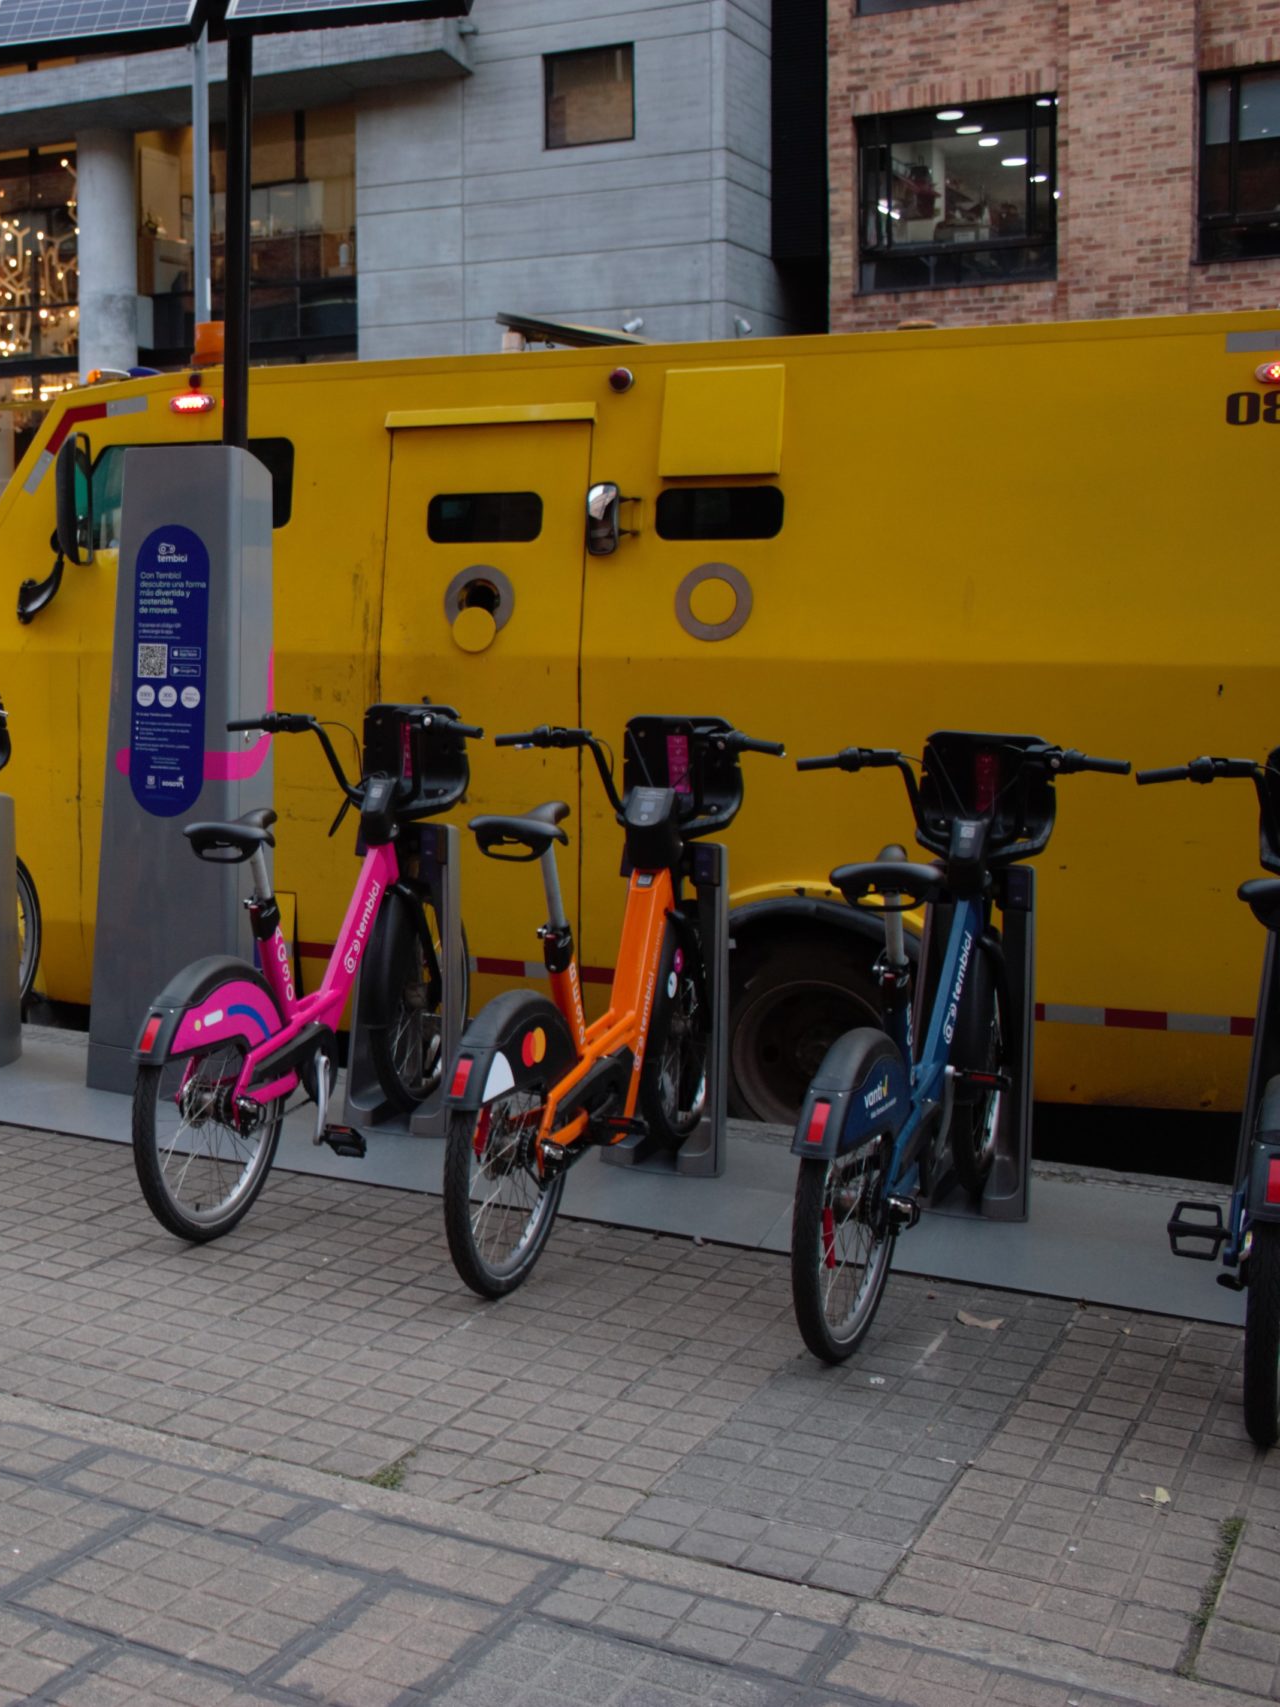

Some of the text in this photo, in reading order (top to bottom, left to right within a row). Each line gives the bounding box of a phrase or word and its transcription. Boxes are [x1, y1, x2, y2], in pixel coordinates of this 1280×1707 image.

[157, 554, 188, 563] tembici
[355, 879, 382, 939] tembici
[951, 930, 973, 1003] tembici
[639, 971, 655, 1035] tembici
